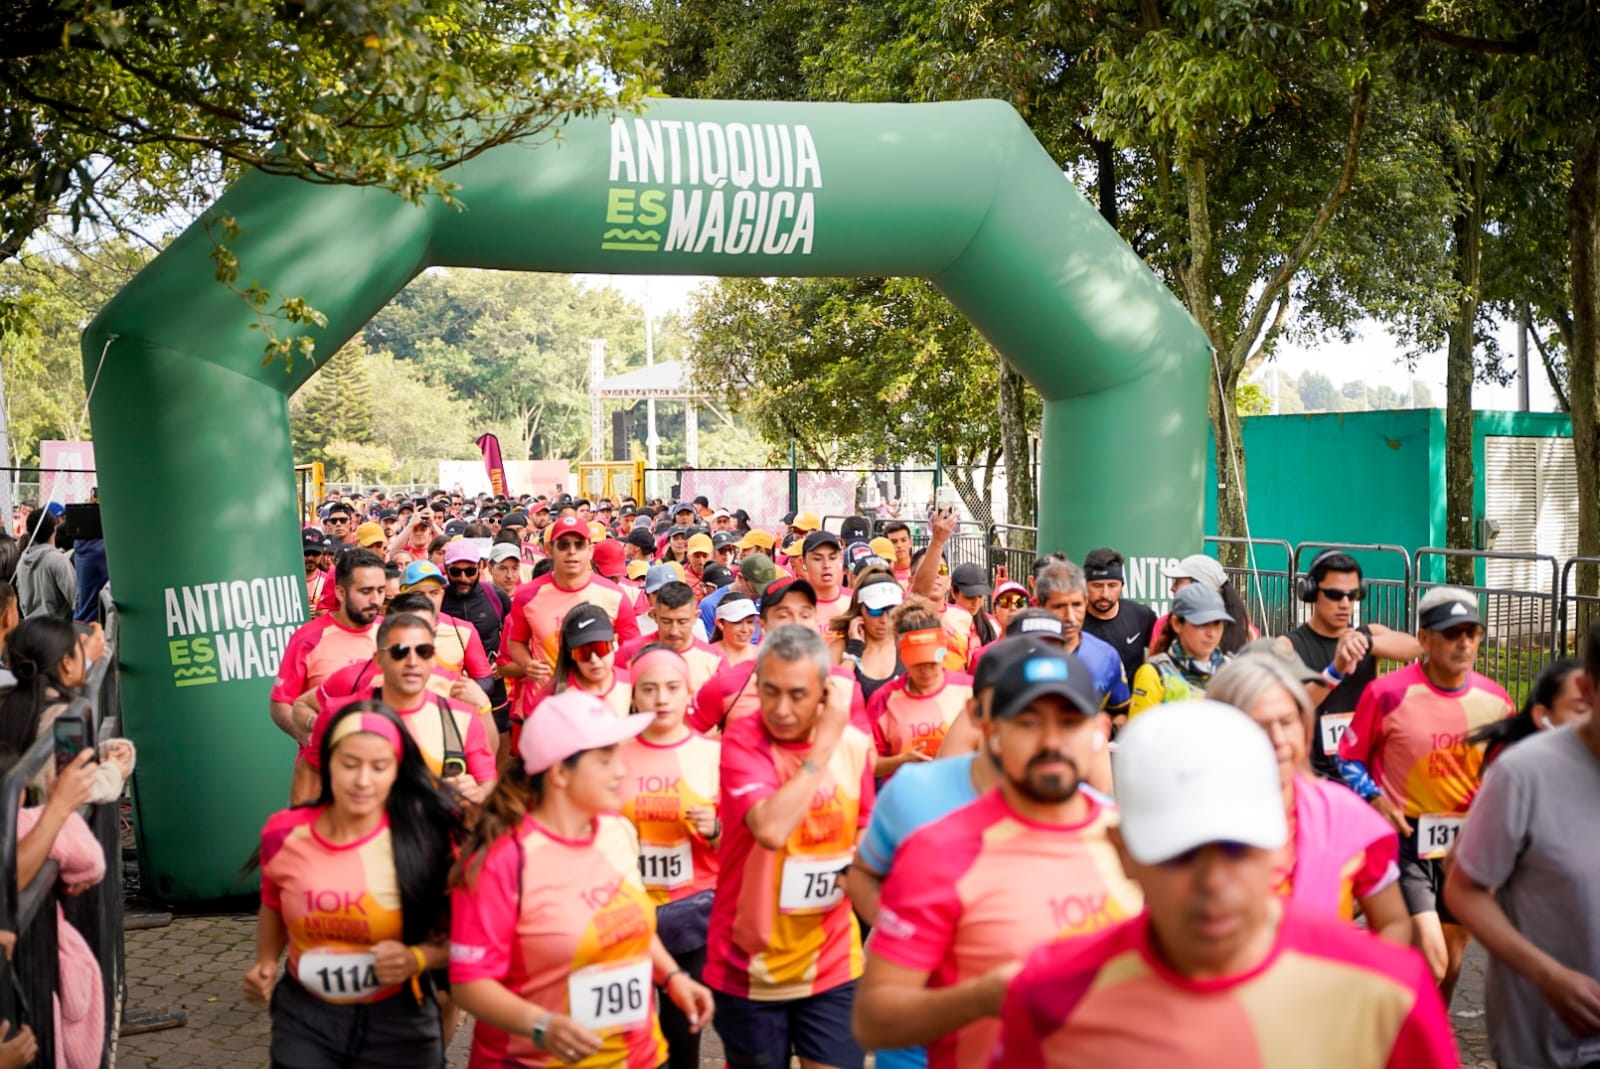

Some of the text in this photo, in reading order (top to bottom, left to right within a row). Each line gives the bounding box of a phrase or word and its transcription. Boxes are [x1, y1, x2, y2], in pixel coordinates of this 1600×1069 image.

[609, 117, 822, 189] ANTIOQUIA
[606, 179, 815, 254] ES MÁGICA
[164, 575, 304, 637] ANTIOQUIA
[169, 637, 215, 665] ES
[637, 776, 681, 794] 10K
[638, 854, 682, 878] 1115
[304, 889, 367, 916] 10K
[316, 964, 381, 992] 1114
[591, 978, 643, 1018] 796
